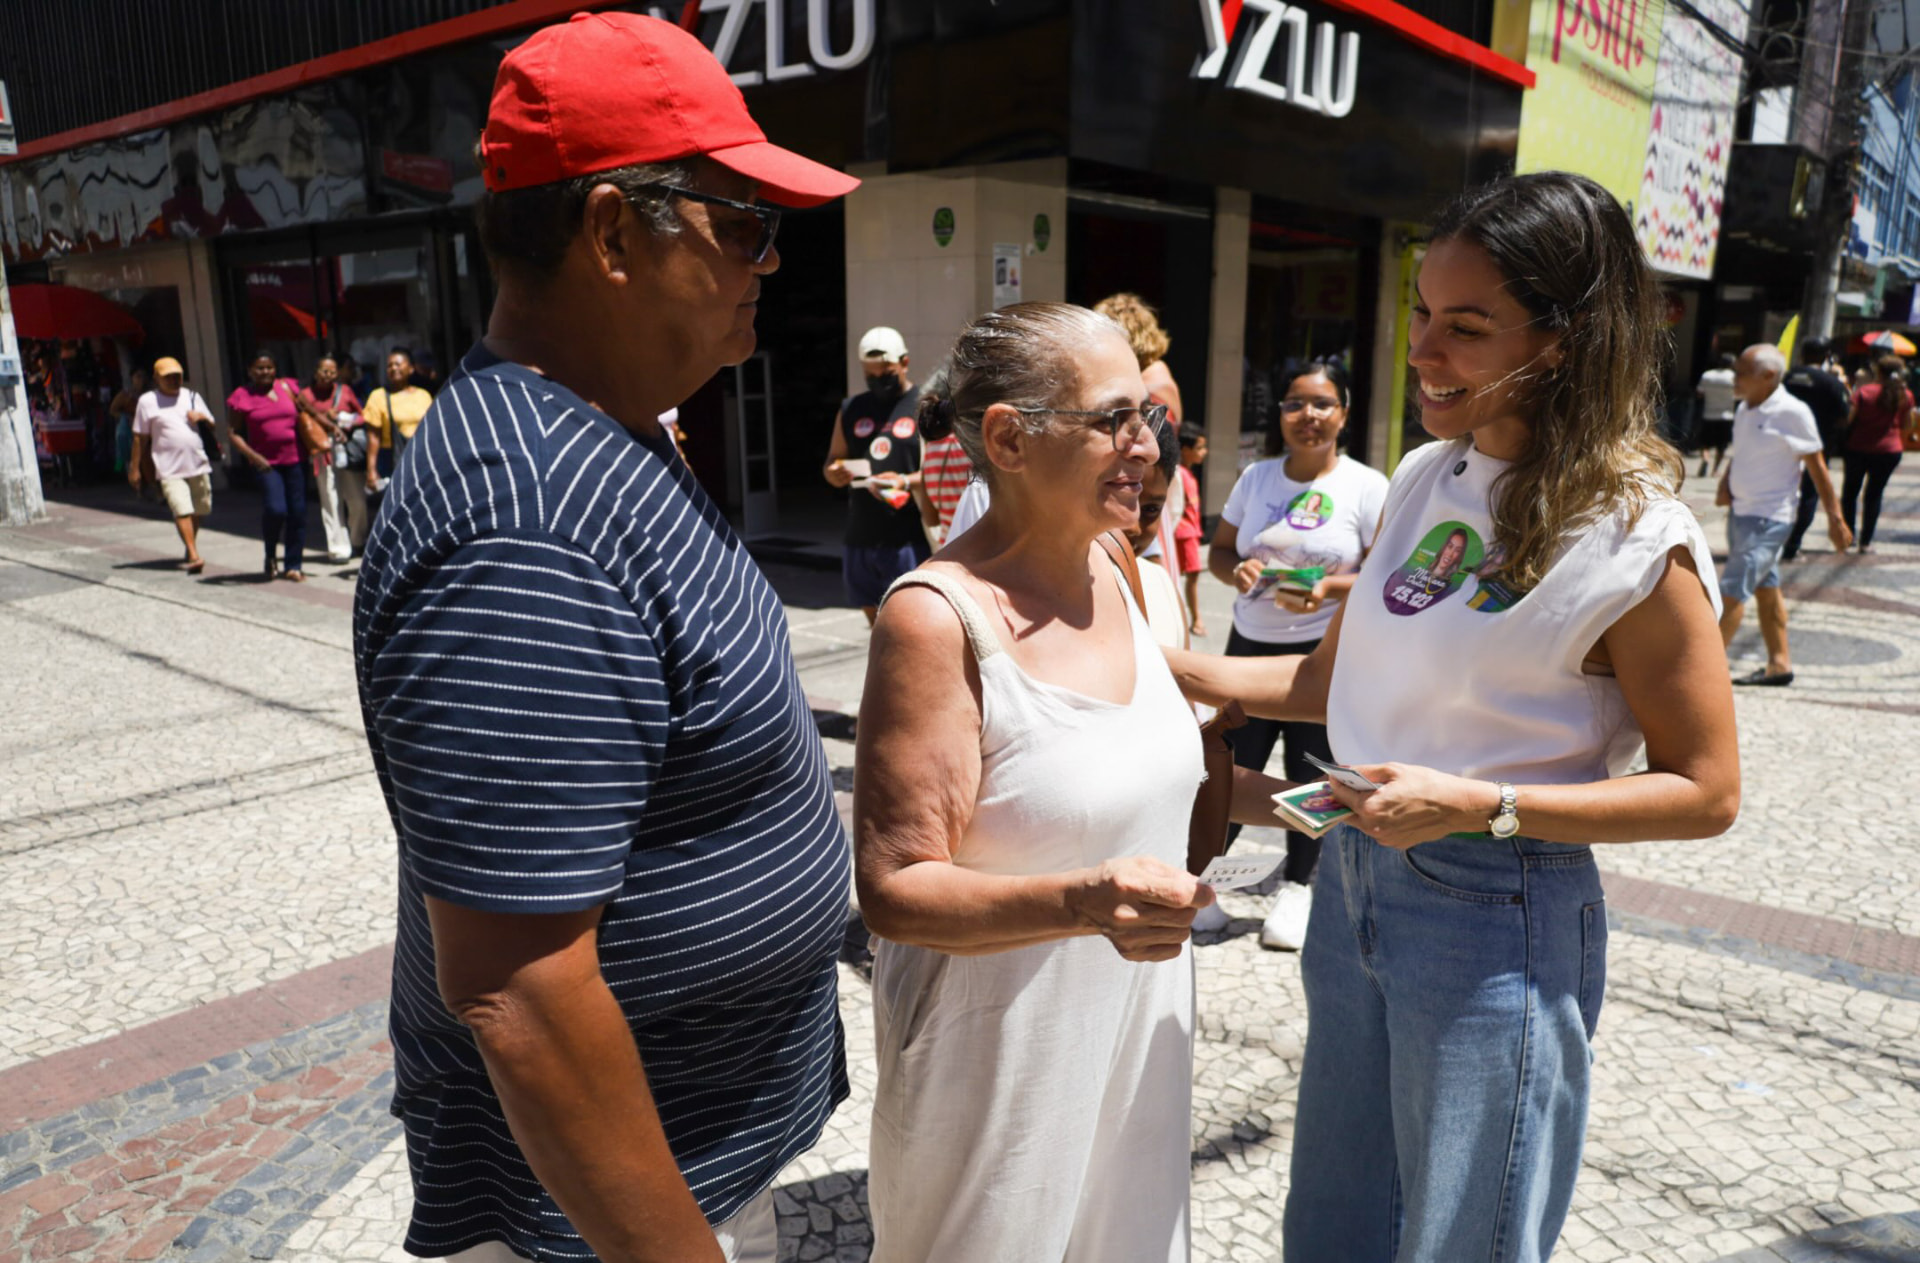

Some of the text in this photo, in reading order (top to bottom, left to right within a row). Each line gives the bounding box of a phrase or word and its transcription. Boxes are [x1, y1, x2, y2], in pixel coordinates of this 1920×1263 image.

[649, 0, 877, 86] ZLU
[1190, 0, 1360, 118] YZLU
[1390, 586, 1434, 609] 15.123
